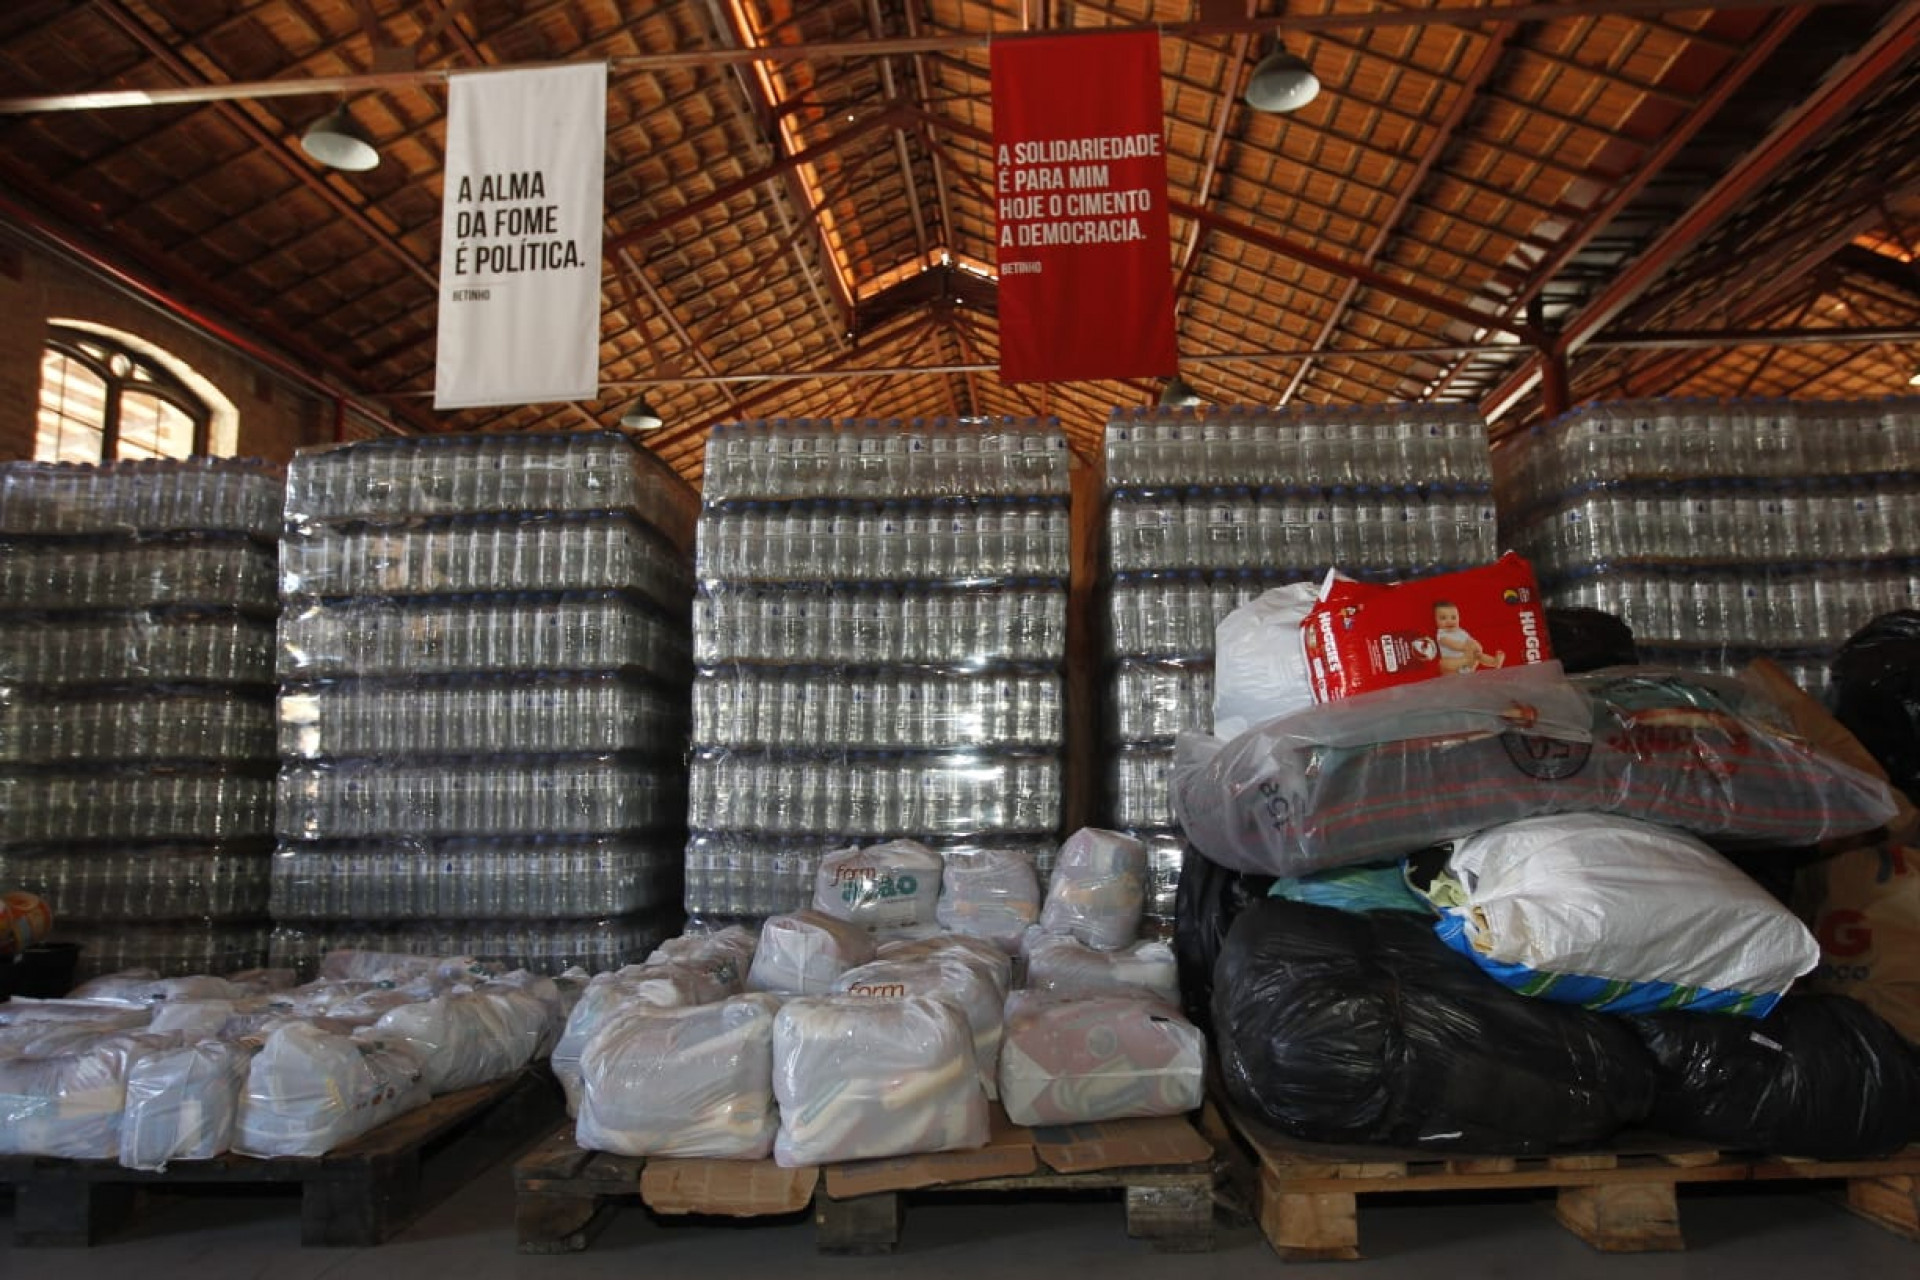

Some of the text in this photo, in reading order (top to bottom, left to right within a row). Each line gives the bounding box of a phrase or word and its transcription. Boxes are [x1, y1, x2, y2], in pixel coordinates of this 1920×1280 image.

[998, 134, 1161, 166] A SOLIDARIEDADE
[458, 171, 545, 203] A ALMA
[998, 165, 1110, 193] É PARA MIM
[1000, 189, 1151, 220] HOJE O CIMENTO
[457, 205, 558, 239] DA FOME
[1001, 218, 1147, 248] A DEMOCRACIA.
[455, 238, 585, 275] É POLÍTICA.
[1001, 261, 1042, 275] BETINHO
[453, 289, 490, 301] BETINHO
[1520, 611, 1543, 664] HUGGI
